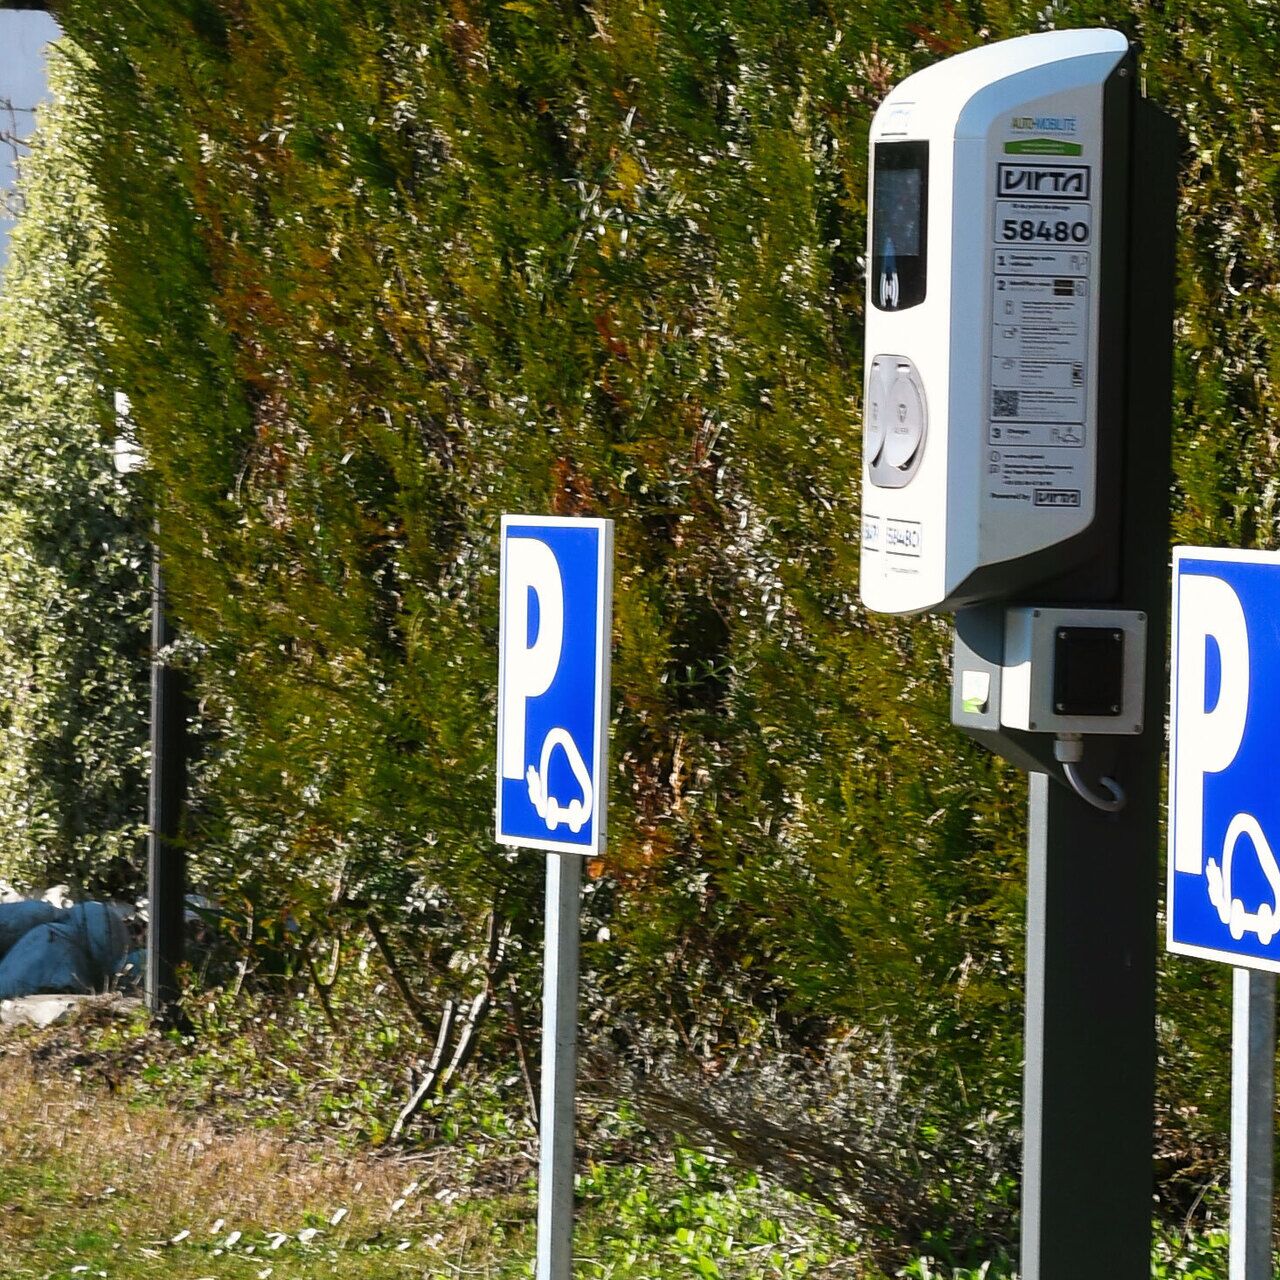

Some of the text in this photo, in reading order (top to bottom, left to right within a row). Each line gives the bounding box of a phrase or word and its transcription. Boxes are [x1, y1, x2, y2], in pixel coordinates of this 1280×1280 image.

[1003, 219, 1090, 243] 58480
[997, 255, 1007, 267] 1
[997, 280, 1007, 291] 2
[991, 427, 1001, 439] 3
[503, 537, 564, 781] P
[1175, 573, 1250, 876] P
